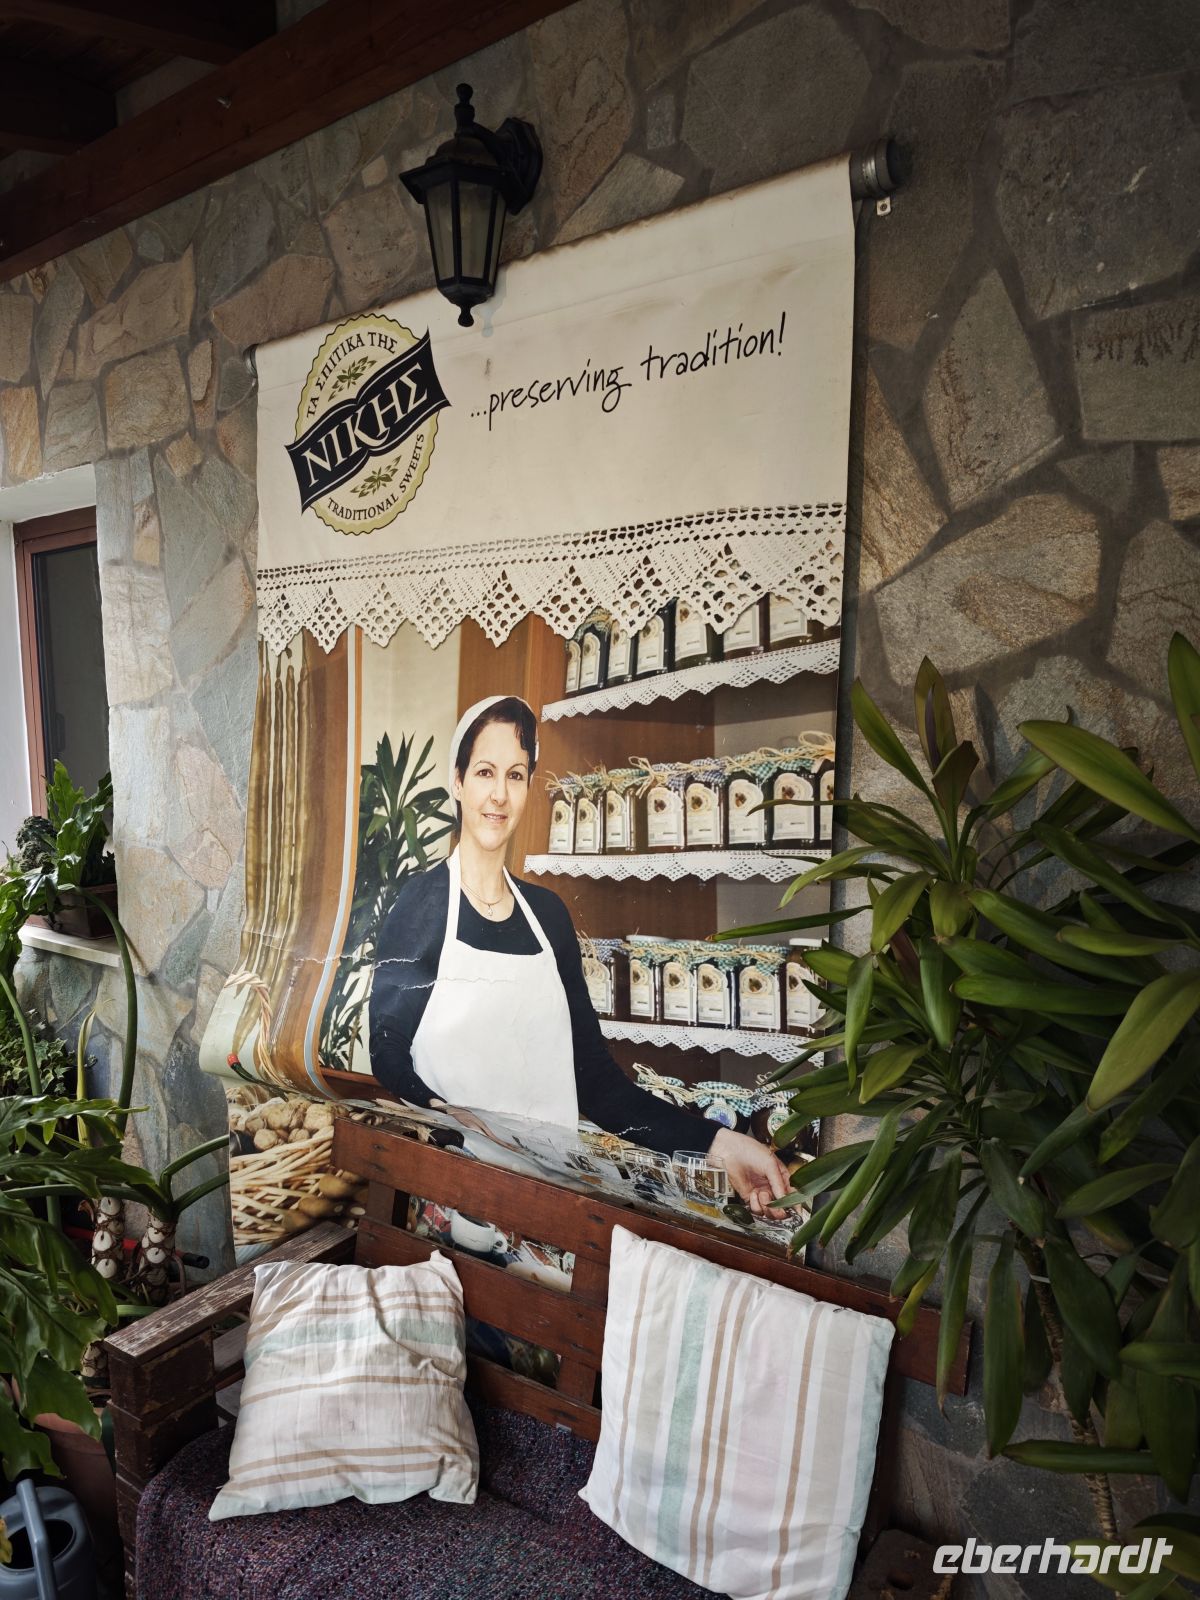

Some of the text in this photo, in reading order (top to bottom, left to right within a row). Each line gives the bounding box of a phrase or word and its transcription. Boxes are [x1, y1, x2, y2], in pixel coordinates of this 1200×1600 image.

[306, 331, 398, 418] ΤΑ ΣΠΙΤΙΚΑ ΤΗΣ
[470, 311, 786, 432] ...preserving tradition!
[302, 362, 428, 488] ΝΙΚΗΣ
[327, 433, 425, 521] TRADITIONAL SWEETS
